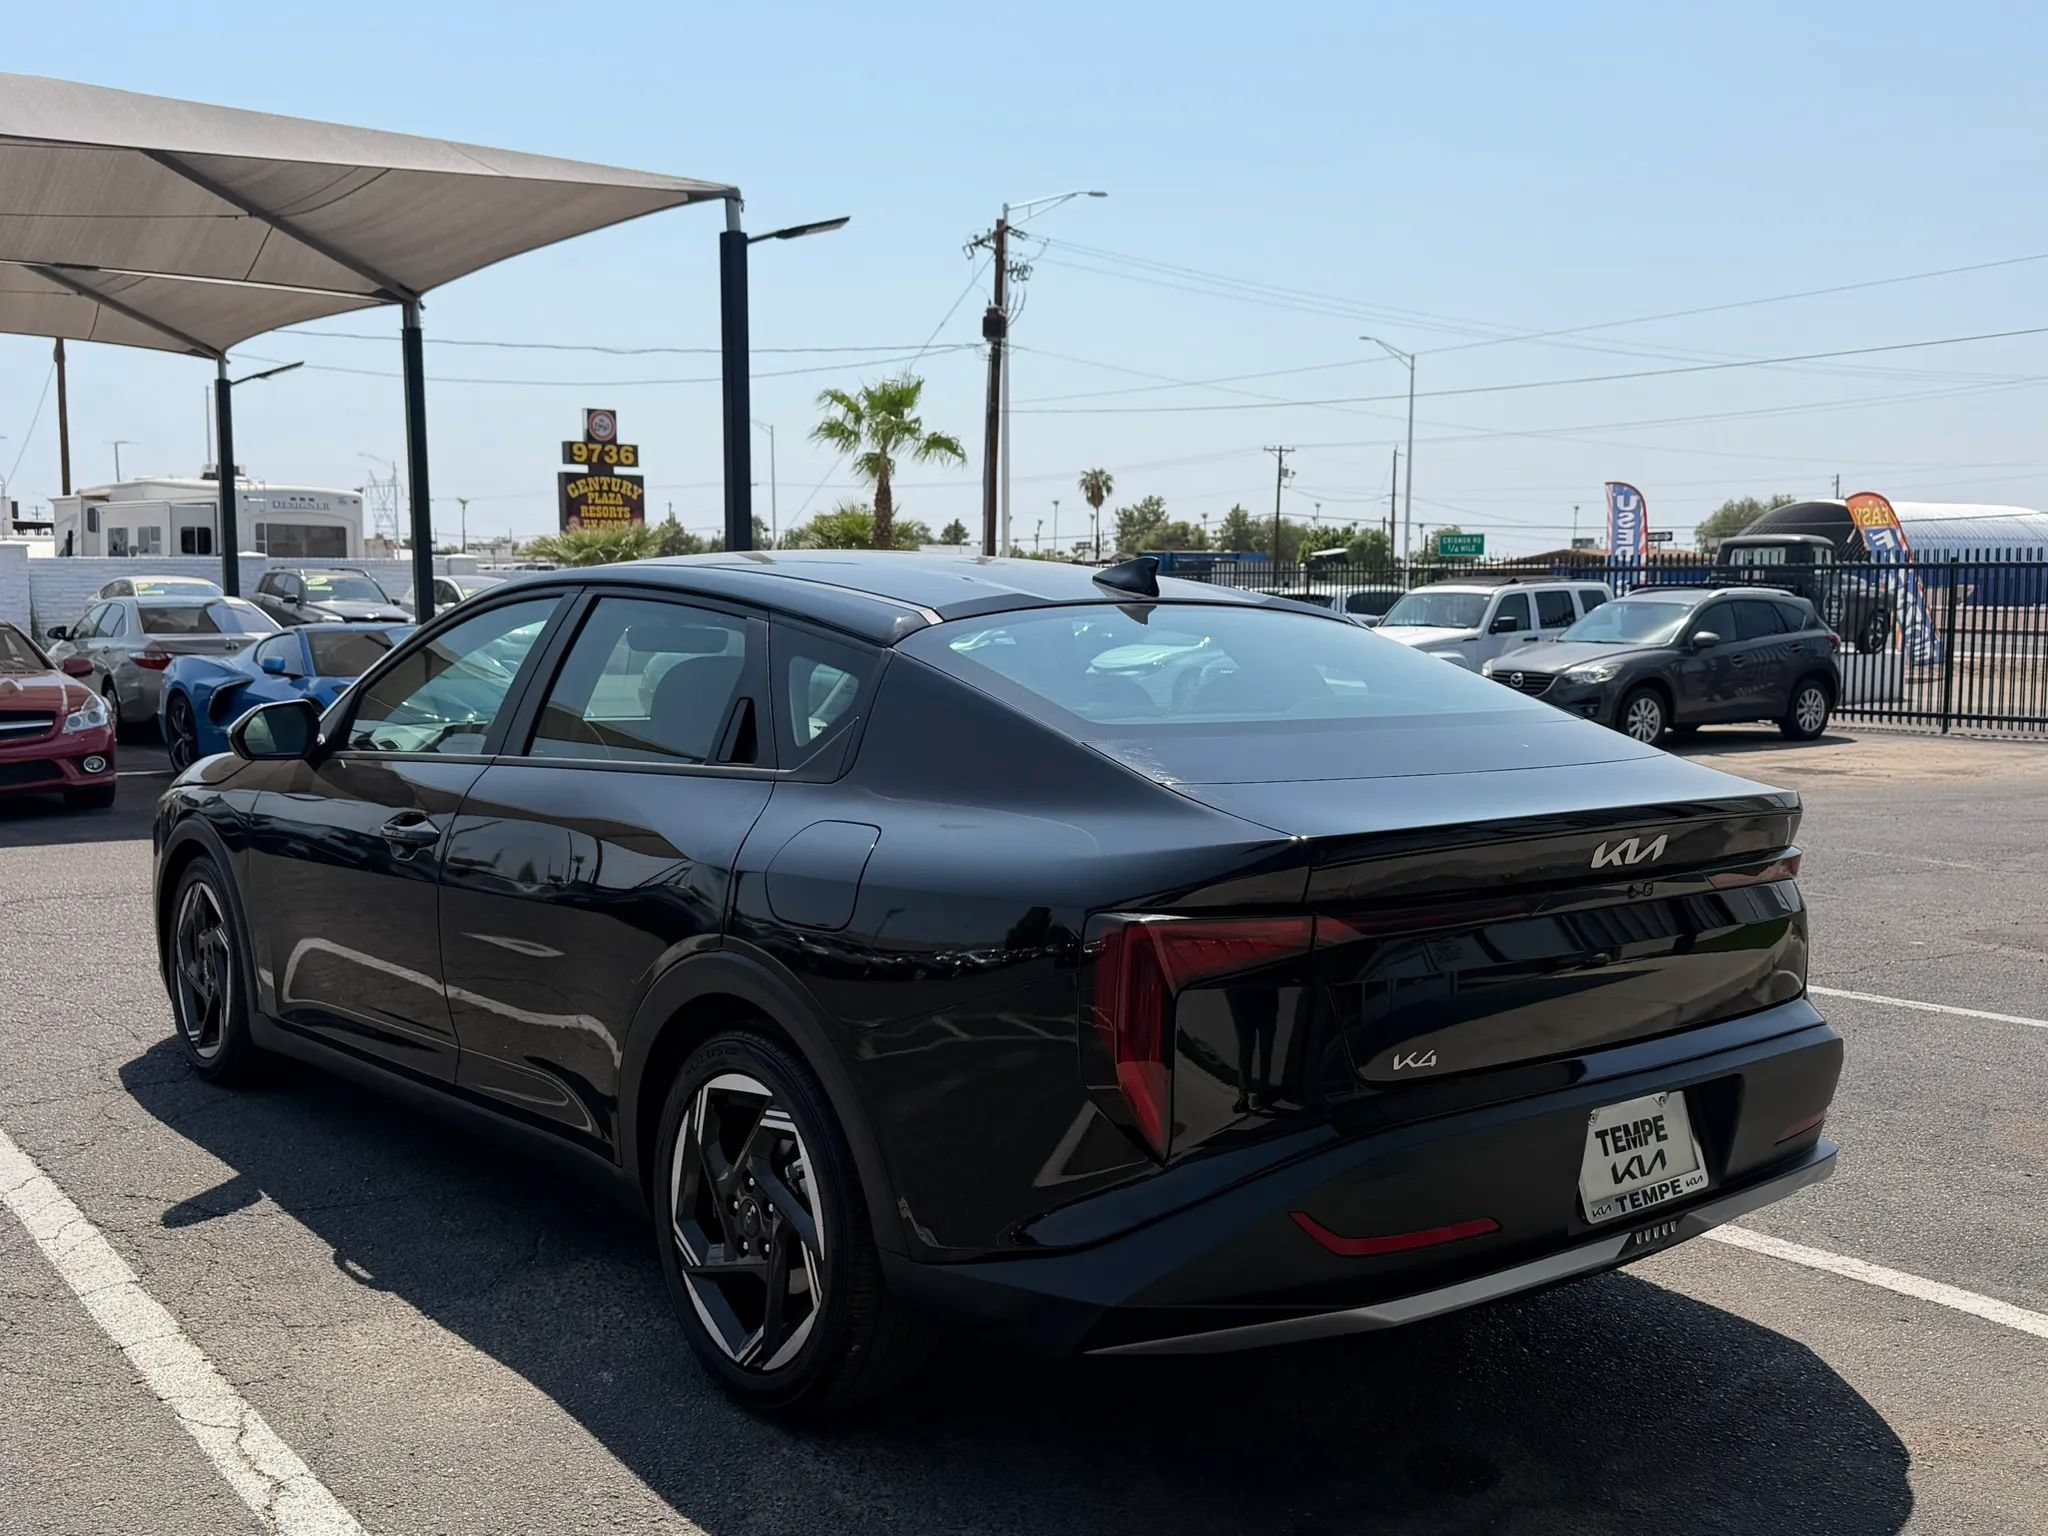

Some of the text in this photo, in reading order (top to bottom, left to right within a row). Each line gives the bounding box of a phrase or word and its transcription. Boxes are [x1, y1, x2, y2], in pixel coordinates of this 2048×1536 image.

[572, 443, 635, 465] 9736
[567, 476, 643, 500] CENTURY
[588, 492, 624, 505] PLAZA
[272, 501, 331, 511] DESIGNER
[580, 505, 631, 518] RESORTS
[1448, 544, 1459, 553] 1/4
[1591, 834, 1669, 869] KIA
[1393, 1049, 1437, 1071] K4
[1595, 1115, 1668, 1157] TEMPE
[1611, 1148, 1667, 1185] KIA
[1615, 1179, 1683, 1212] TEMPE
